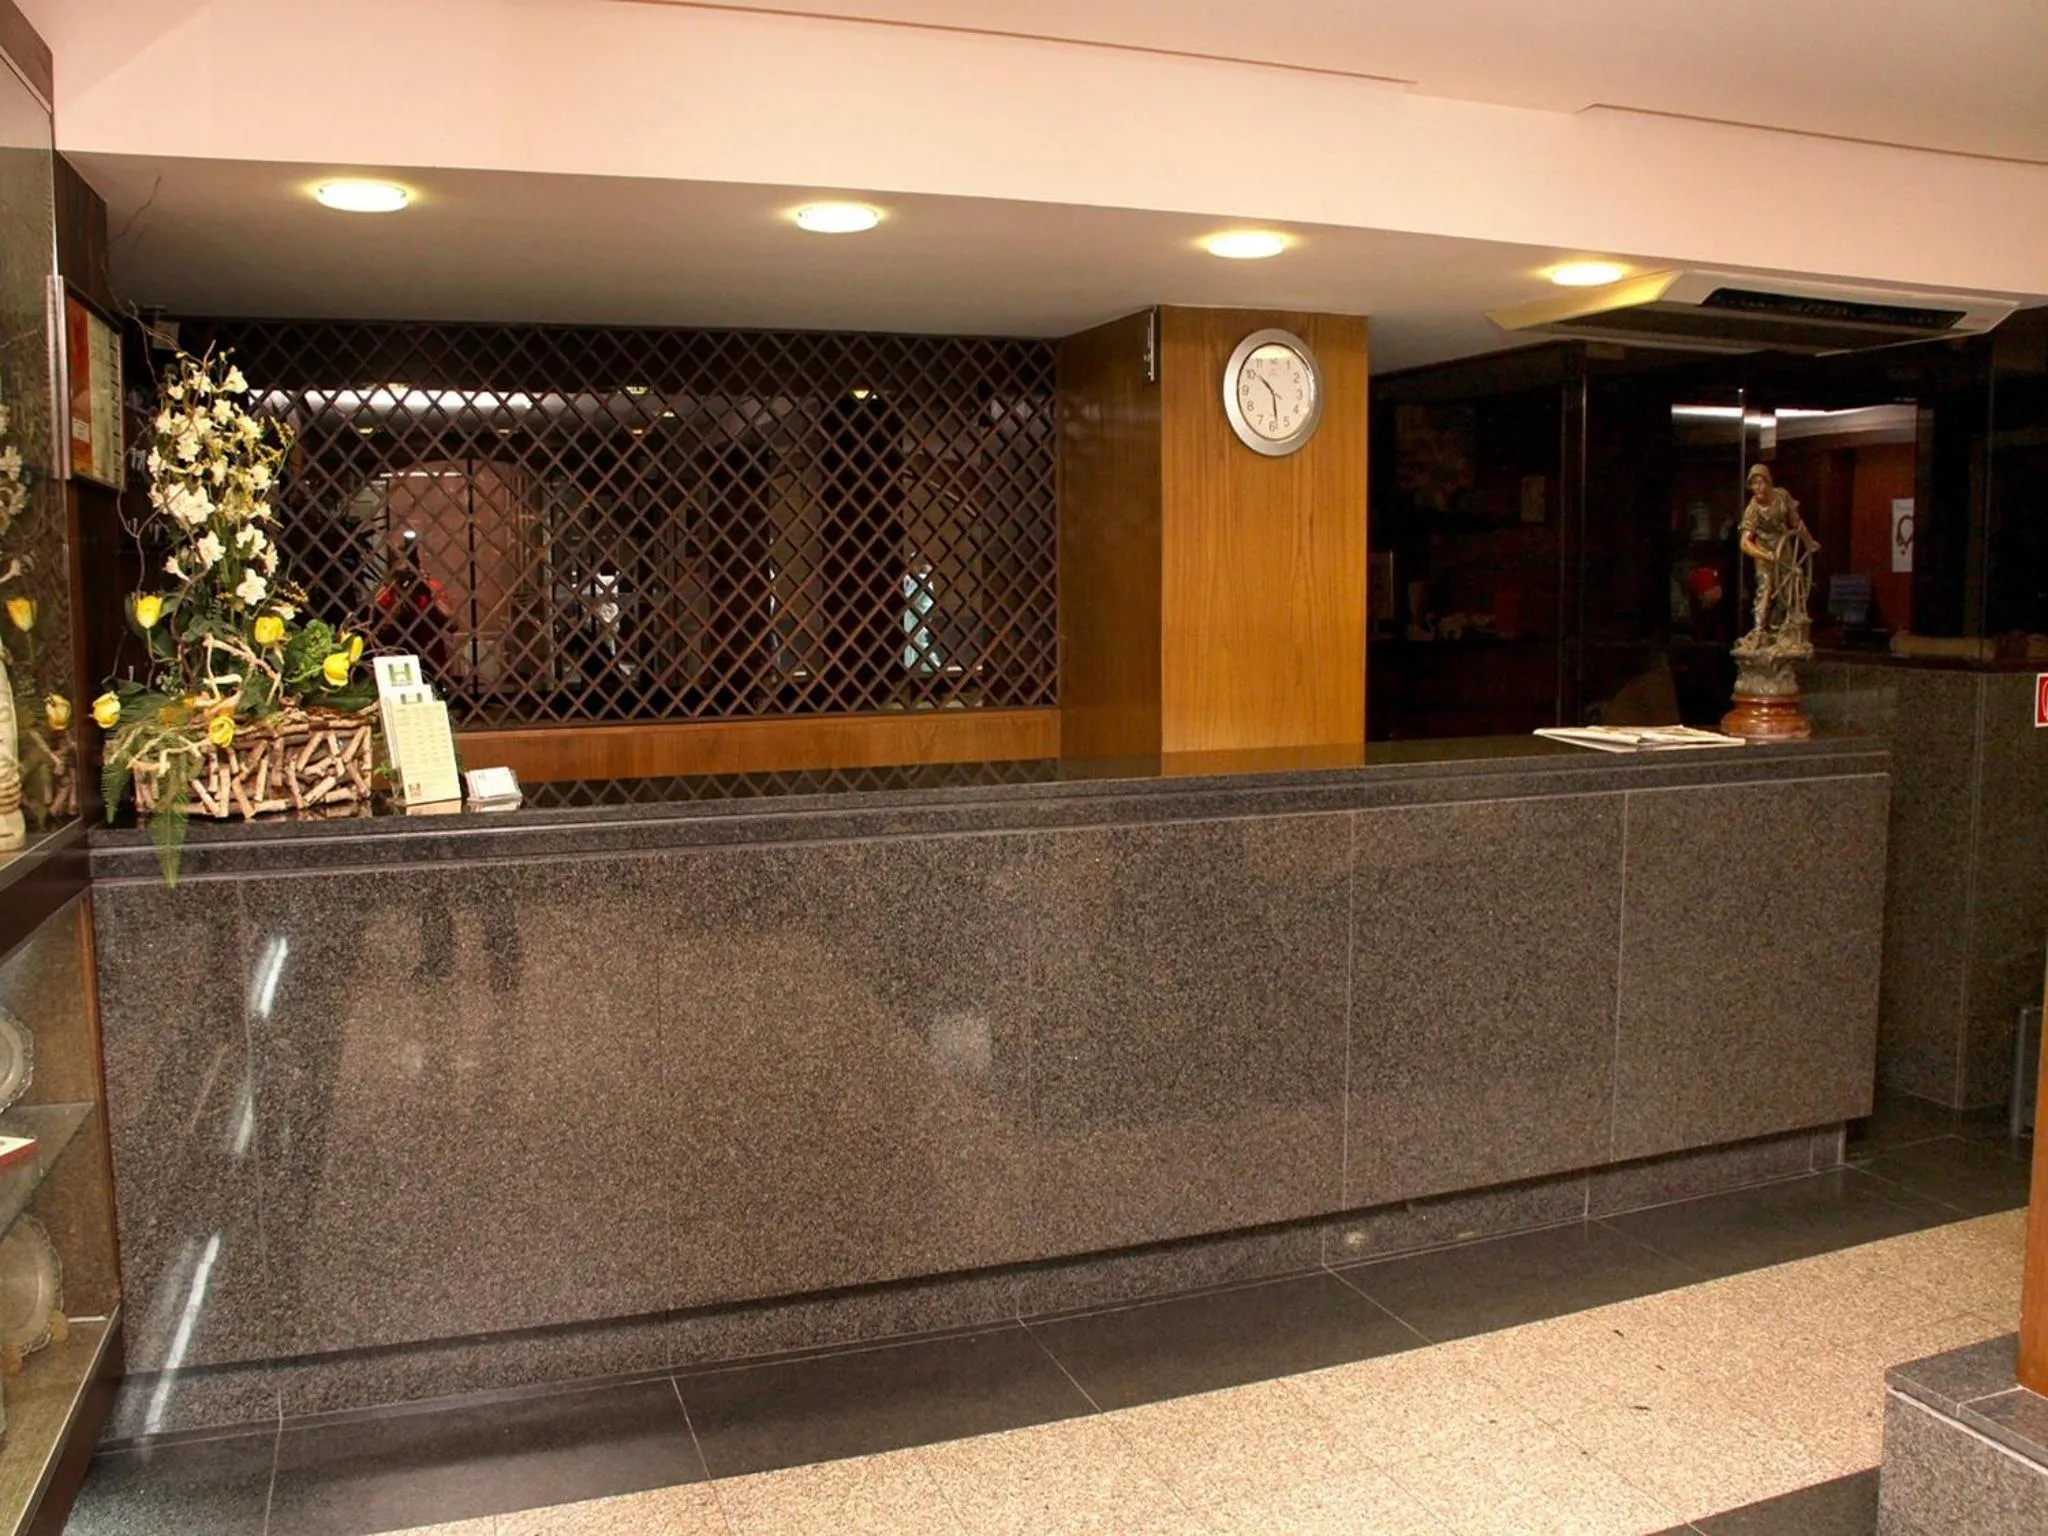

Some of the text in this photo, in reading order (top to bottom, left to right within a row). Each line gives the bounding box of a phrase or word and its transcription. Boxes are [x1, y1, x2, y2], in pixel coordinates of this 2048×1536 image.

[1246, 369, 1256, 380] 10
[1293, 373, 1300, 383] 2
[1242, 385, 1249, 396] 9
[1297, 389, 1303, 400] 3
[1247, 401, 1254, 411] 8
[1293, 404, 1299, 414] 4
[1256, 414, 1263, 425] 7
[1284, 416, 1290, 427] 5
[388, 663, 413, 683] H
